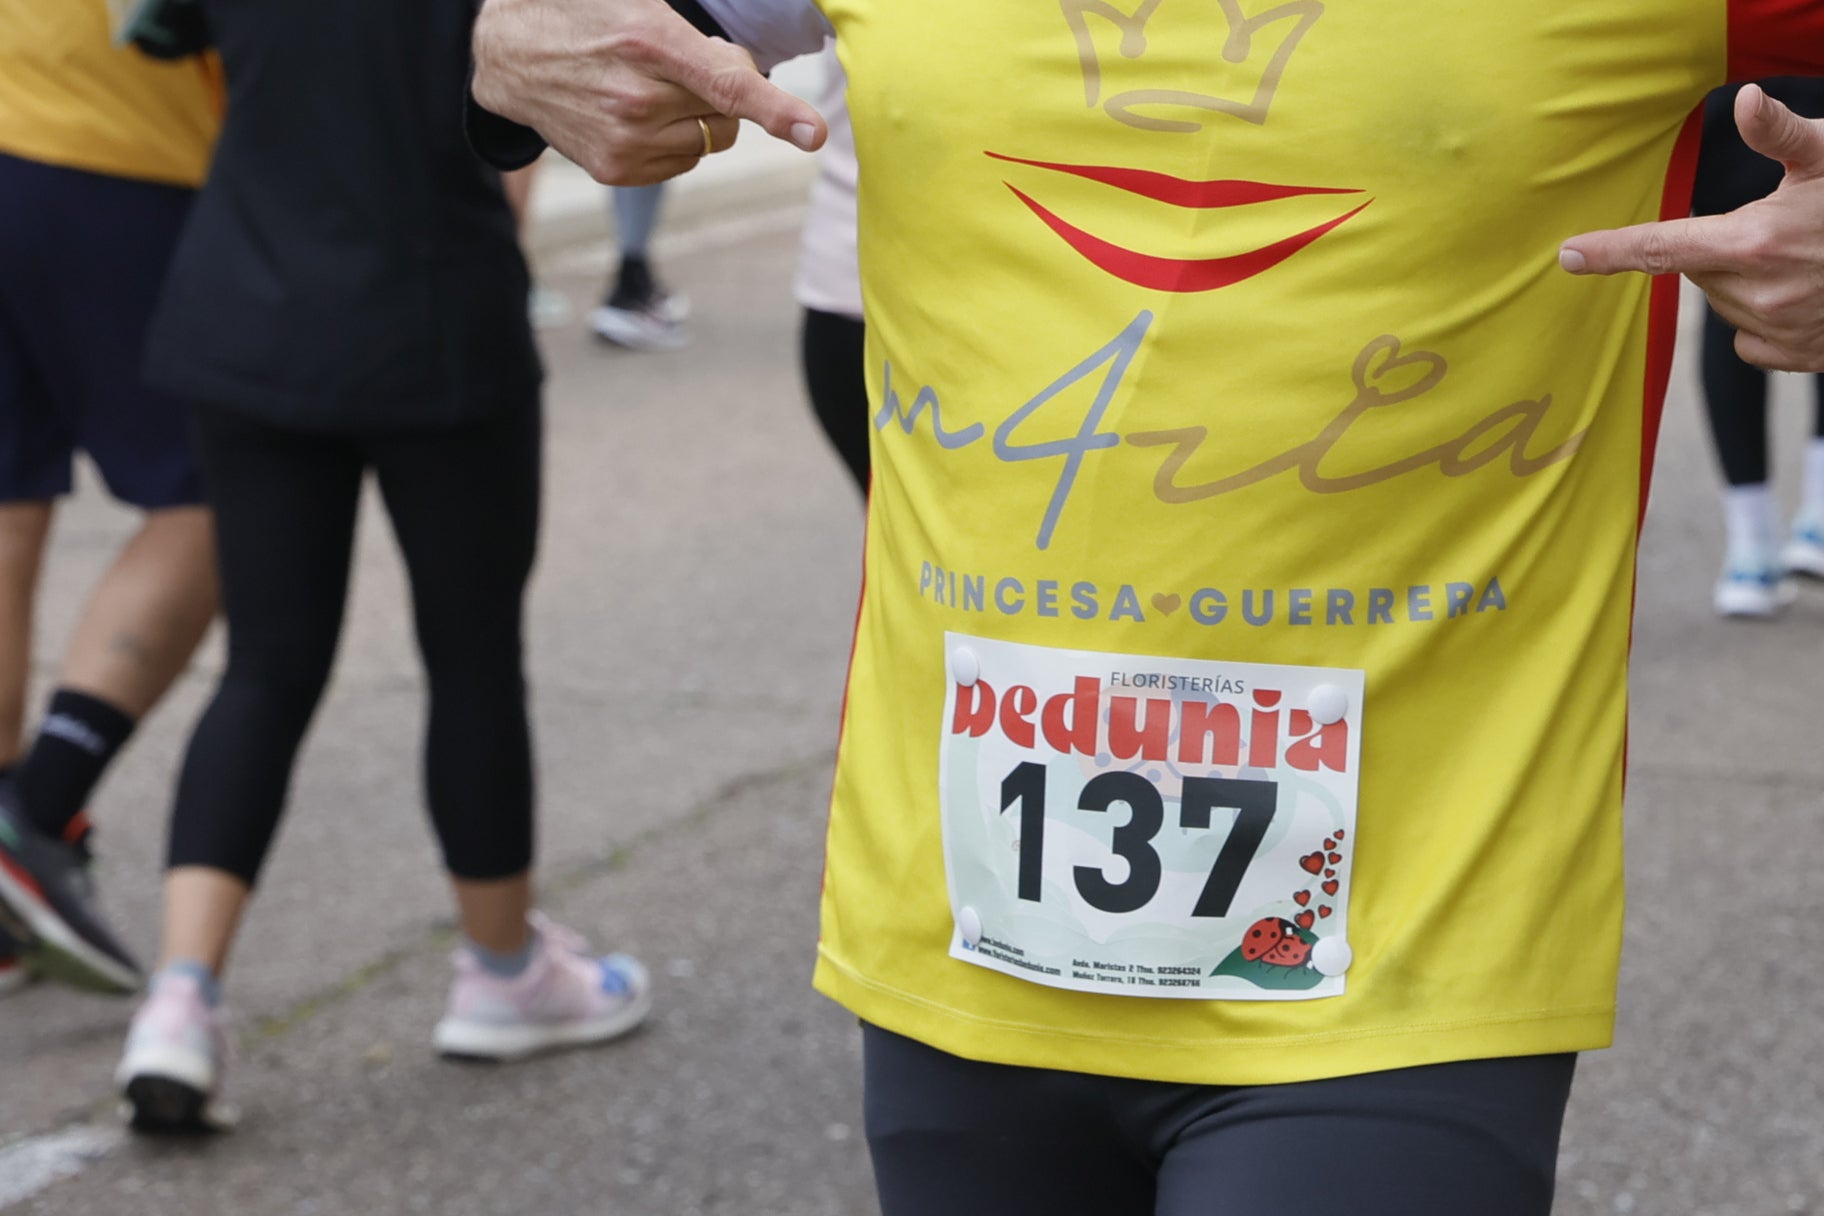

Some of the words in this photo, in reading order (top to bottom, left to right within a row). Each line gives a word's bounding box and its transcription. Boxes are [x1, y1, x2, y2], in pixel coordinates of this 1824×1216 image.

[919, 559, 1146, 623] PRINCESA
[1189, 576, 1508, 626] GUERRERA
[1110, 671, 1245, 694] FLORISTERÍAS
[1000, 760, 1278, 917] 137
